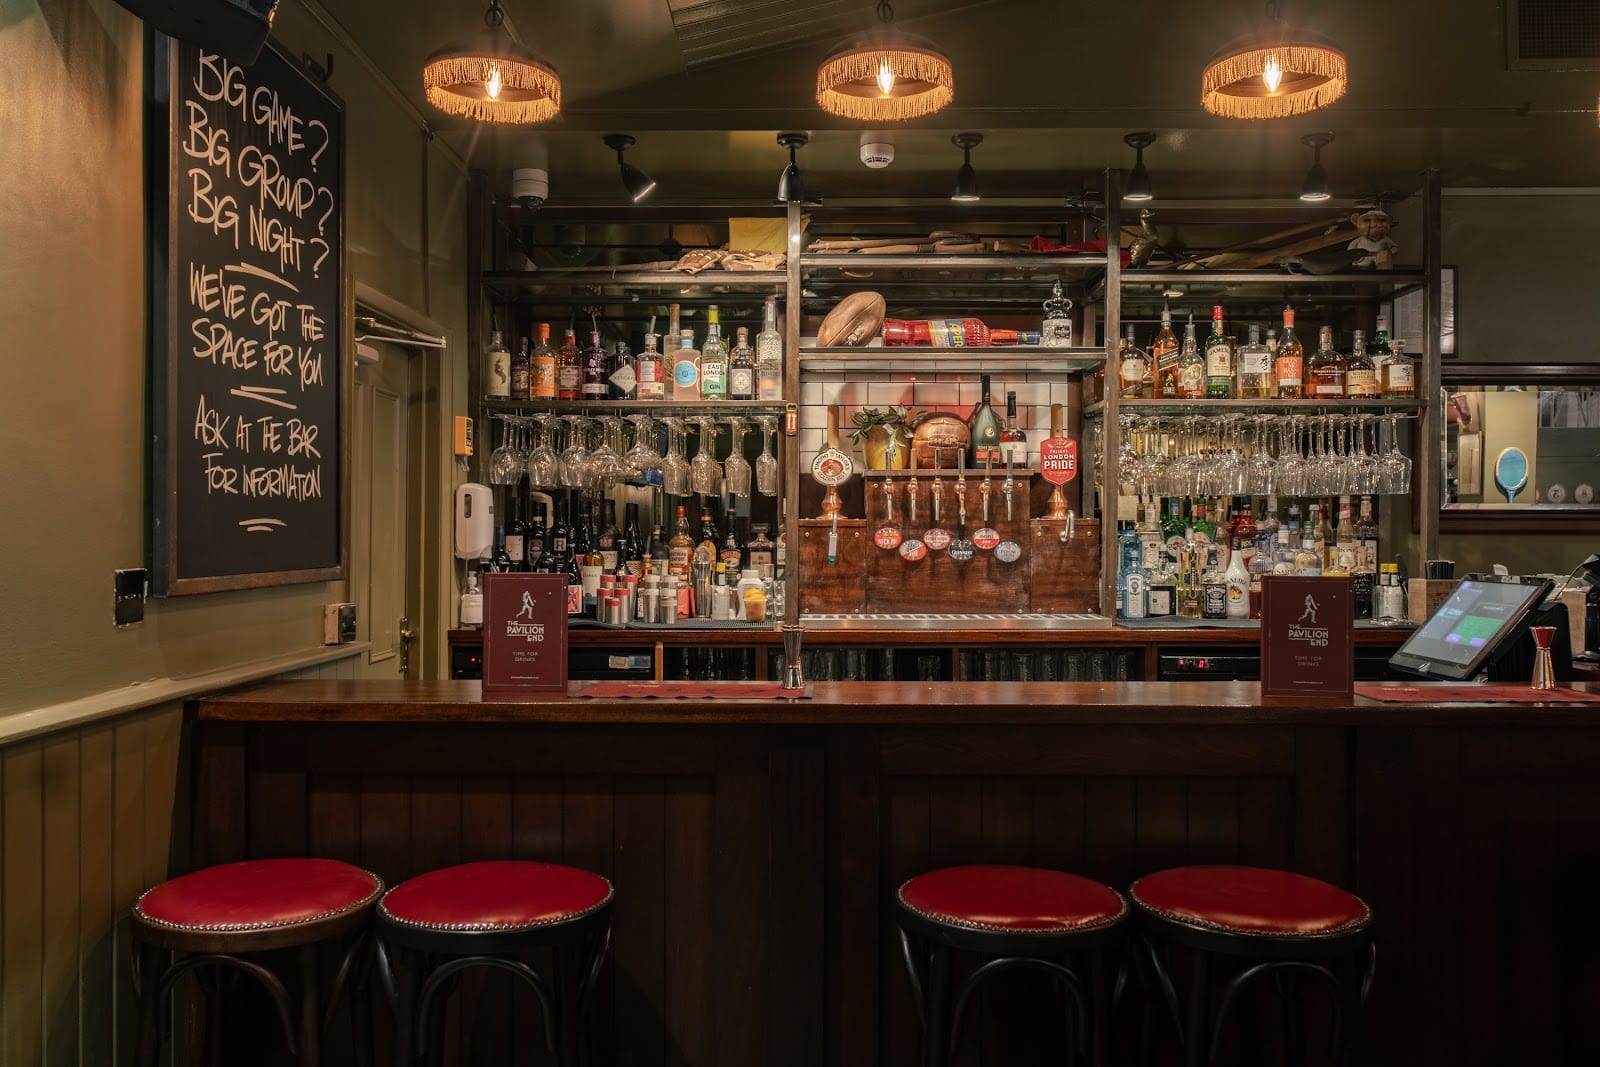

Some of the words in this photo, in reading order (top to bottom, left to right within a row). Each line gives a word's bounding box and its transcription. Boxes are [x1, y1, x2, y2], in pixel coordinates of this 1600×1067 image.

[193, 49, 247, 122] BIG
[252, 86, 328, 173] GAME?
[183, 100, 230, 178] BIG
[238, 145, 333, 236] GROUP?
[188, 168, 240, 250] BIG
[250, 204, 330, 279] NIGHT?
[189, 261, 246, 320] WE'VE
[251, 292, 293, 341] GOT
[296, 304, 325, 342] THE
[191, 318, 258, 370] SPACE
[263, 340, 294, 376] FOR
[298, 347, 323, 392] YOU
[195, 394, 230, 449] ASK
[236, 415, 253, 453] AT
[257, 416, 284, 454] THE
[286, 418, 321, 459] BAR
[202, 453, 238, 494] FOR
[243, 464, 321, 502] INFORMATION
[1044, 460, 1074, 470] PRIDE
[507, 626, 544, 634] PAVILION
[527, 634, 544, 642] END
[1288, 631, 1329, 639] PAVILION
